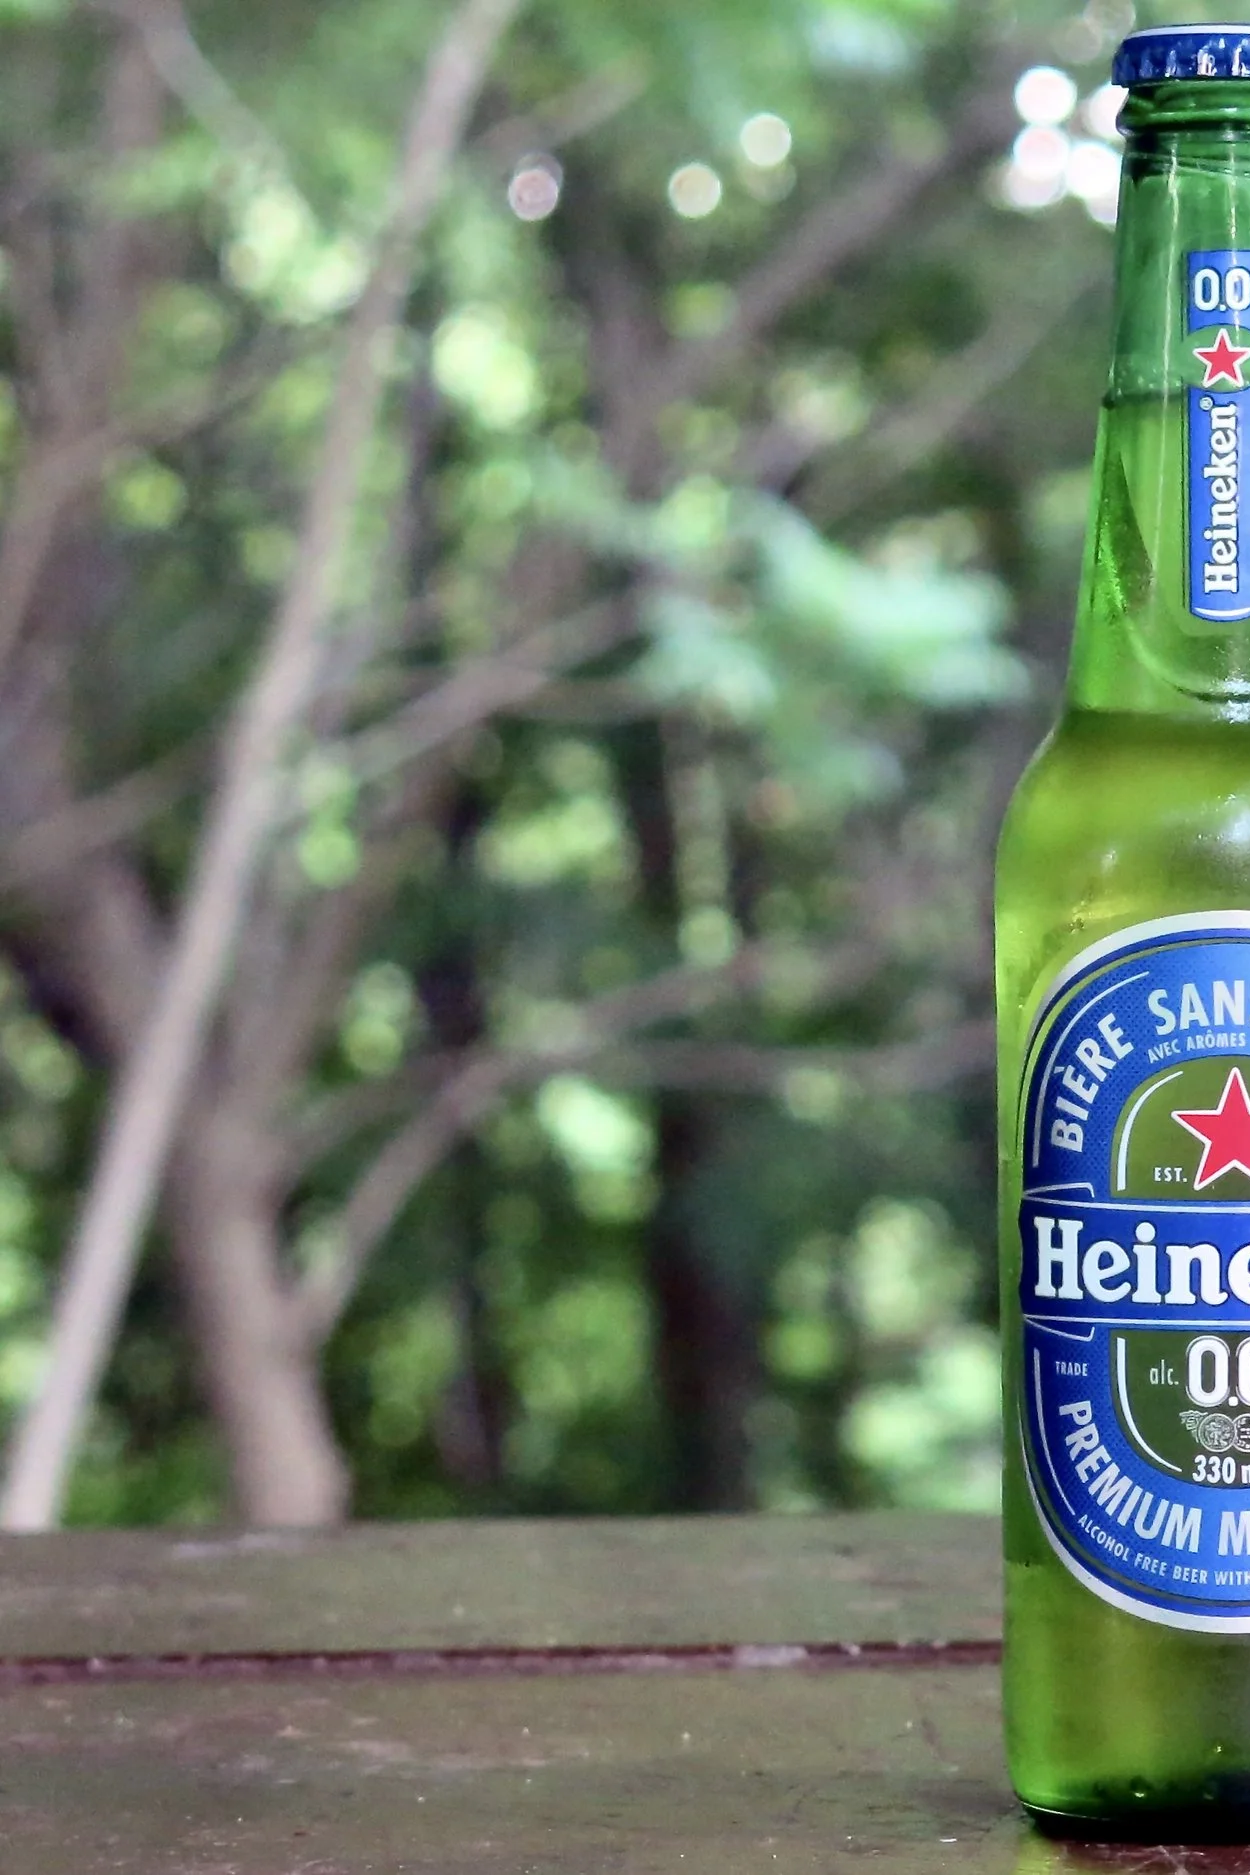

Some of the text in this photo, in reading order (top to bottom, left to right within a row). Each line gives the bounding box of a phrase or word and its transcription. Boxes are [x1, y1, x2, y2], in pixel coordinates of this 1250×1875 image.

[1147, 1045, 1182, 1064] AVEC
[1185, 1029, 1247, 1050] ARÔMES
[1050, 1012, 1134, 1153] BIÈRE
[1153, 1166, 1188, 1183] EST.
[1054, 1361, 1089, 1378] TRADE
[1149, 1359, 1180, 1387] alc.
[1058, 1399, 1203, 1554] PREMIUM
[1192, 1455, 1234, 1484] 330
[1077, 1513, 1130, 1562] ALCOHOL
[1134, 1552, 1168, 1578] FREE
[1172, 1565, 1208, 1585] BEER
